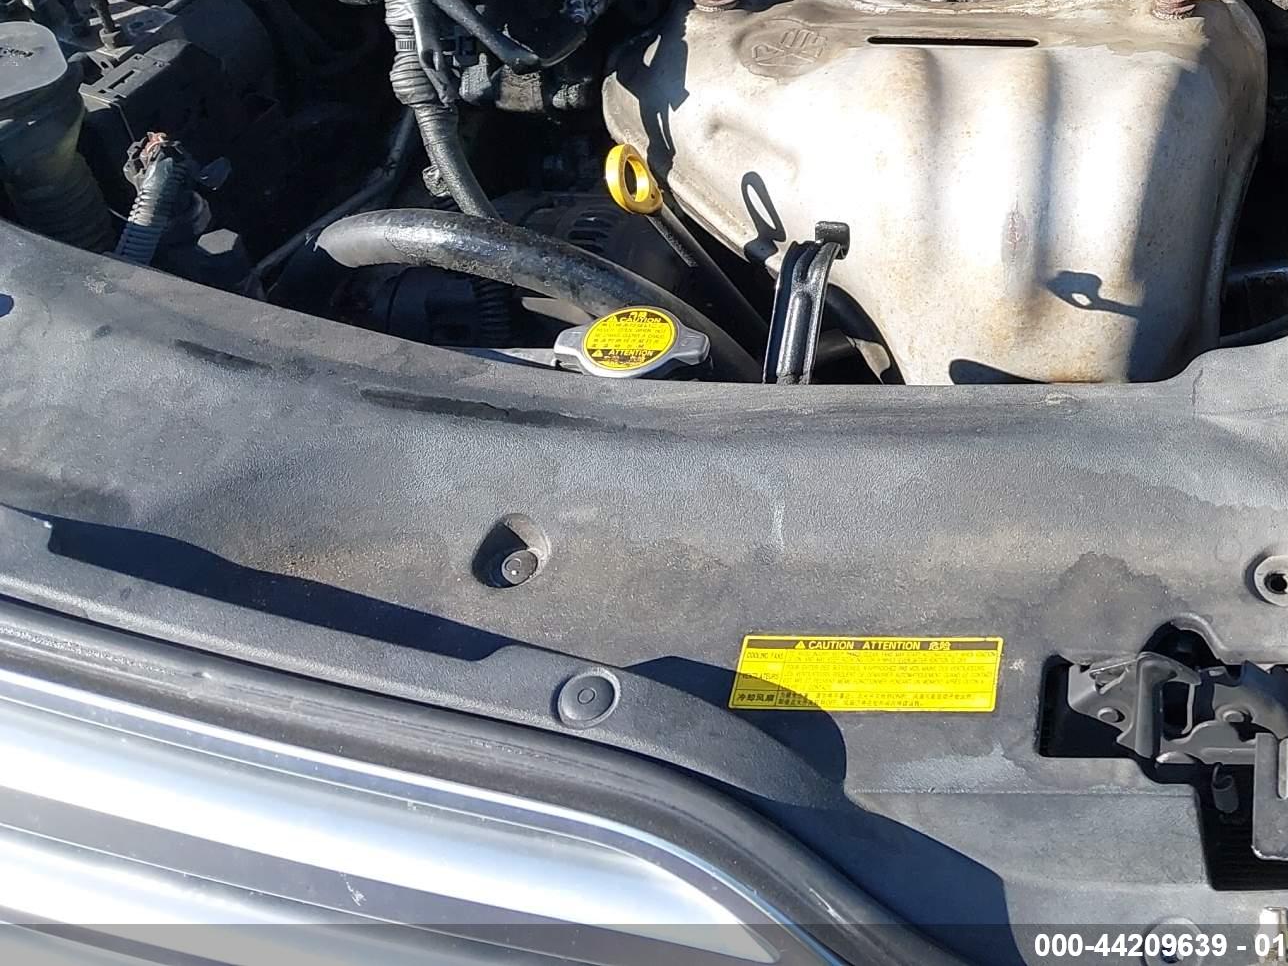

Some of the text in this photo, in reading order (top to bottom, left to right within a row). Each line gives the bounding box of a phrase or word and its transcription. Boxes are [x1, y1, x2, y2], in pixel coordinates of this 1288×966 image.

[608, 349, 654, 357] ATTENTION
[808, 640, 855, 650] CAUTION
[862, 641, 921, 651] ATTENTION
